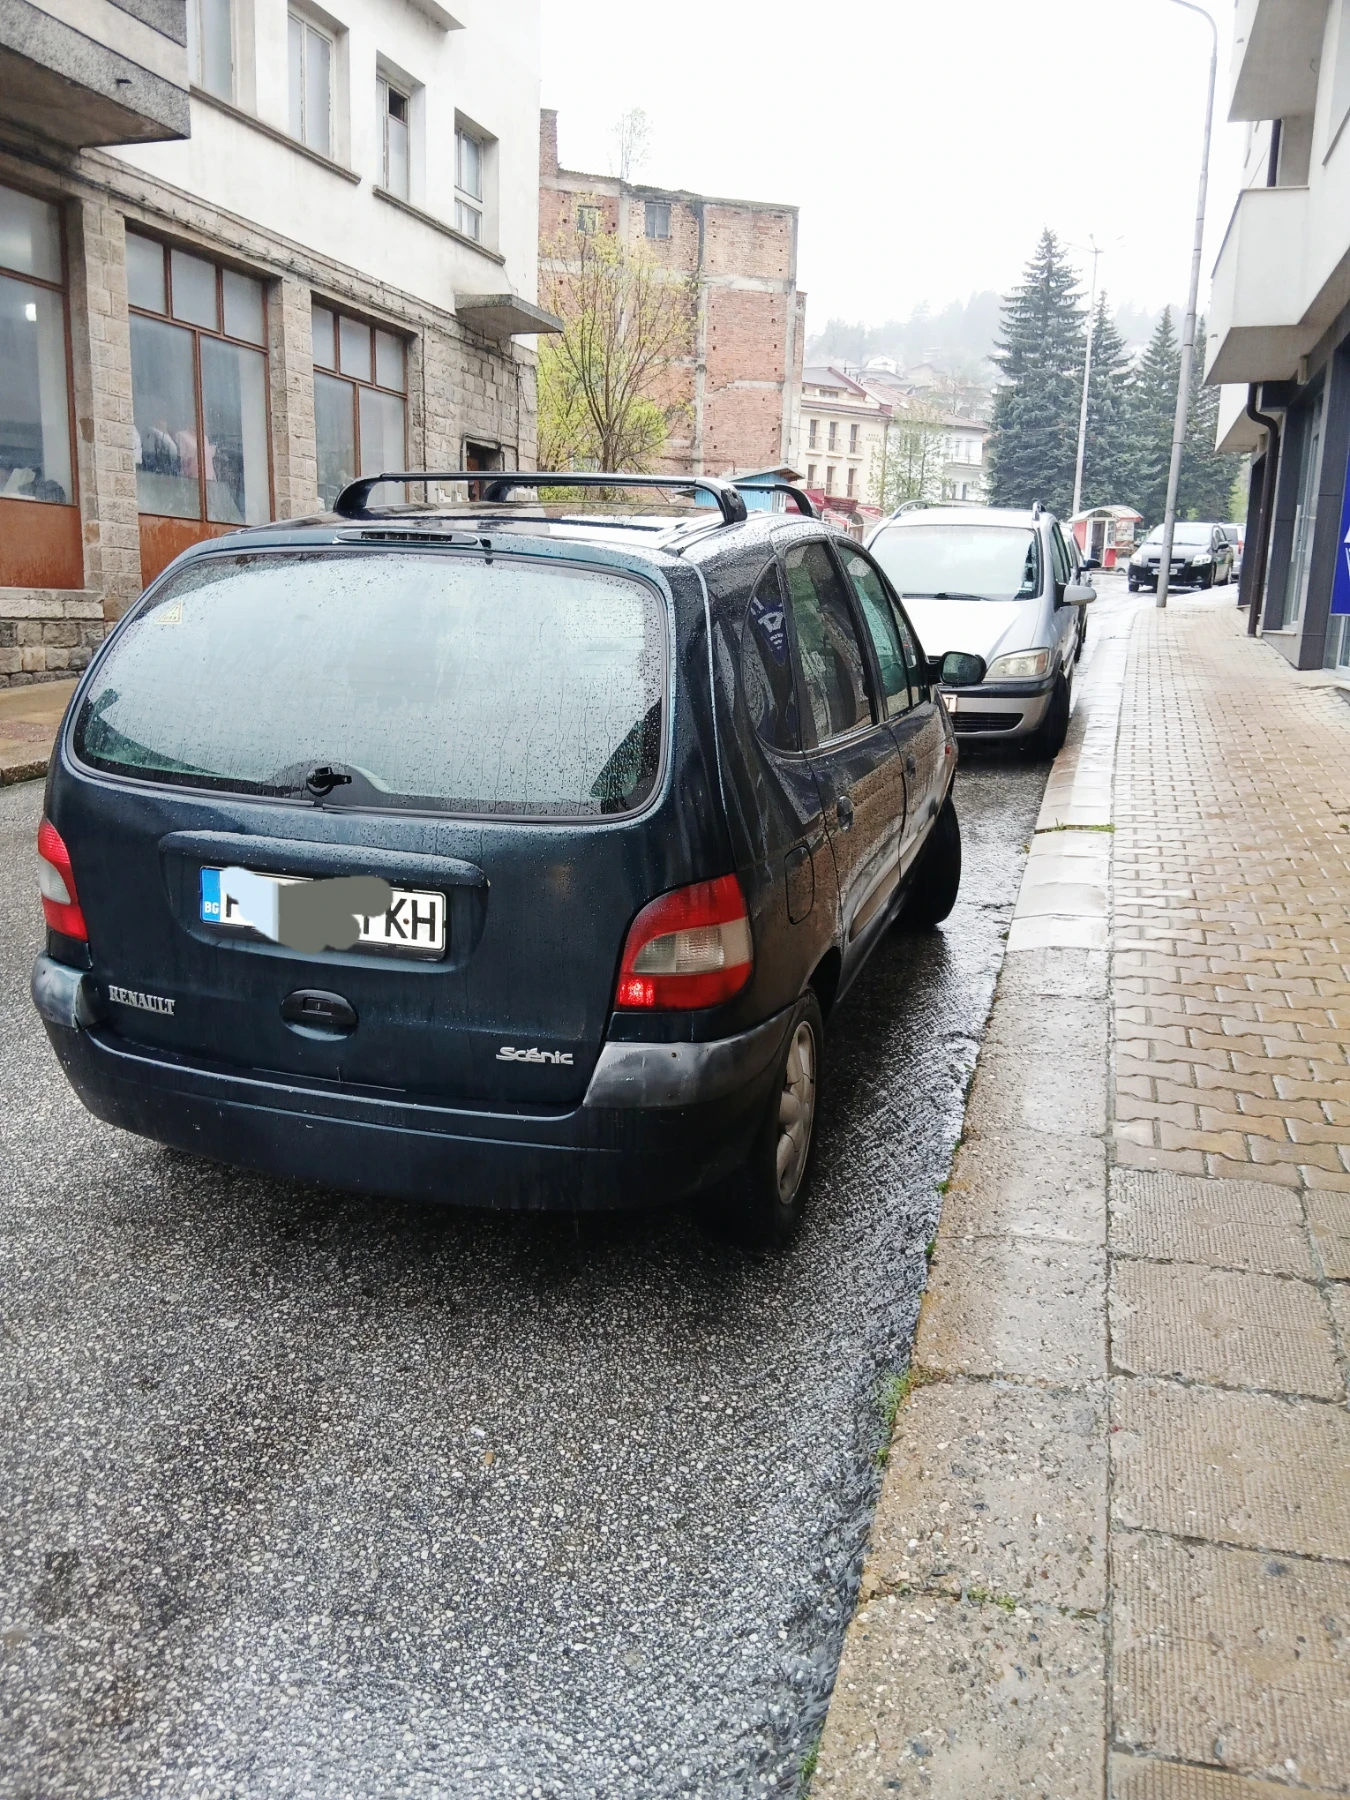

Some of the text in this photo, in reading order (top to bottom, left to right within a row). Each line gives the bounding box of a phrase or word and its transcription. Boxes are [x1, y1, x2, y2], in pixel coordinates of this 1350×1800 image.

[204, 901, 220, 914] BG
[108, 985, 176, 1016] RENAULT
[496, 1046, 575, 1066] Scénic
